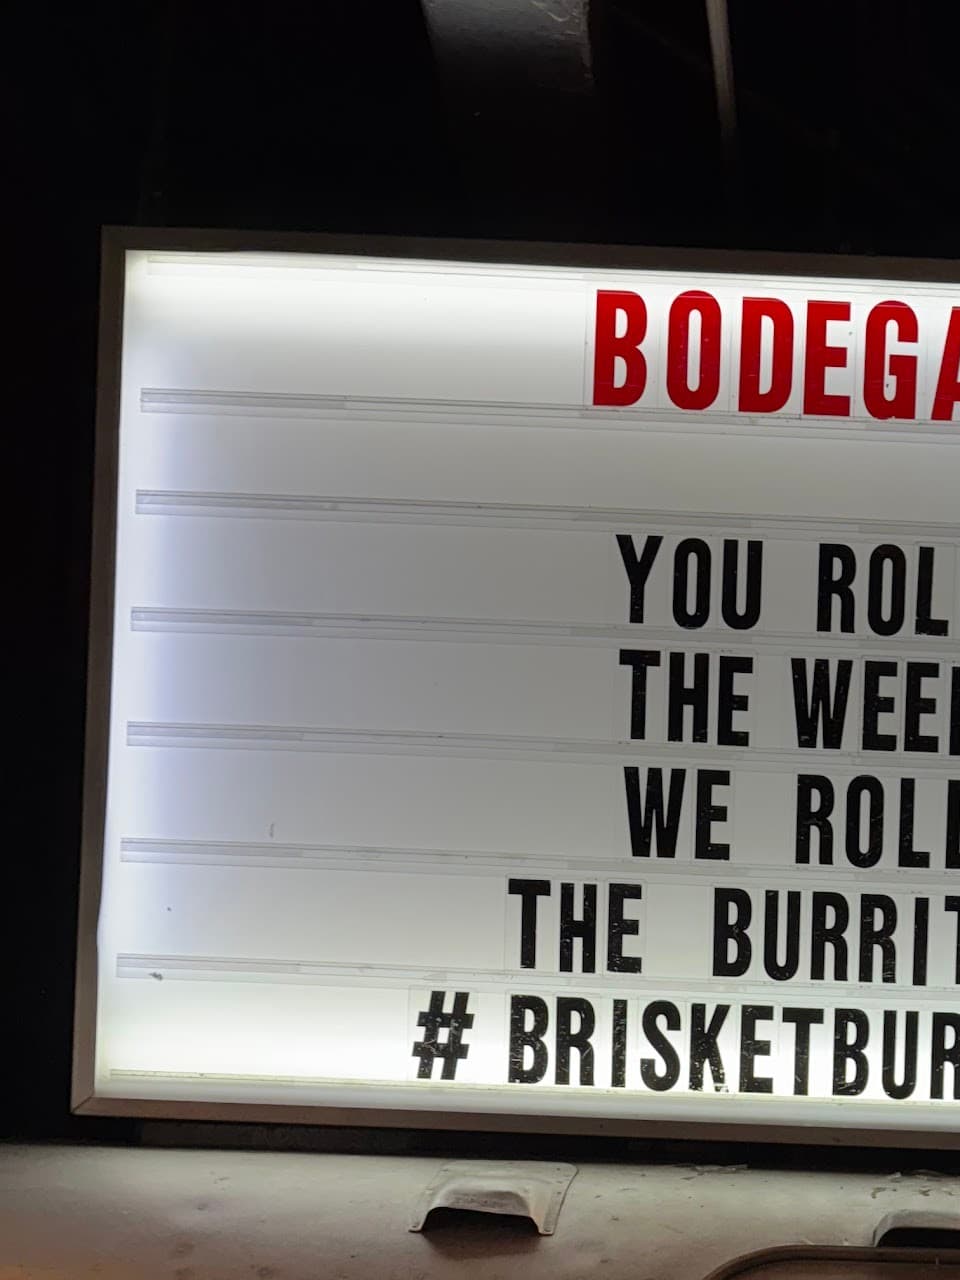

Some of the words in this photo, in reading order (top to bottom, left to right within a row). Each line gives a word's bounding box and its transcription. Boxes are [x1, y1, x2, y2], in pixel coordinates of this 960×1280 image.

[615, 534, 763, 631] YOU
[619, 649, 753, 747] THE
[624, 766, 731, 861] WE
[508, 878, 643, 975] THE
